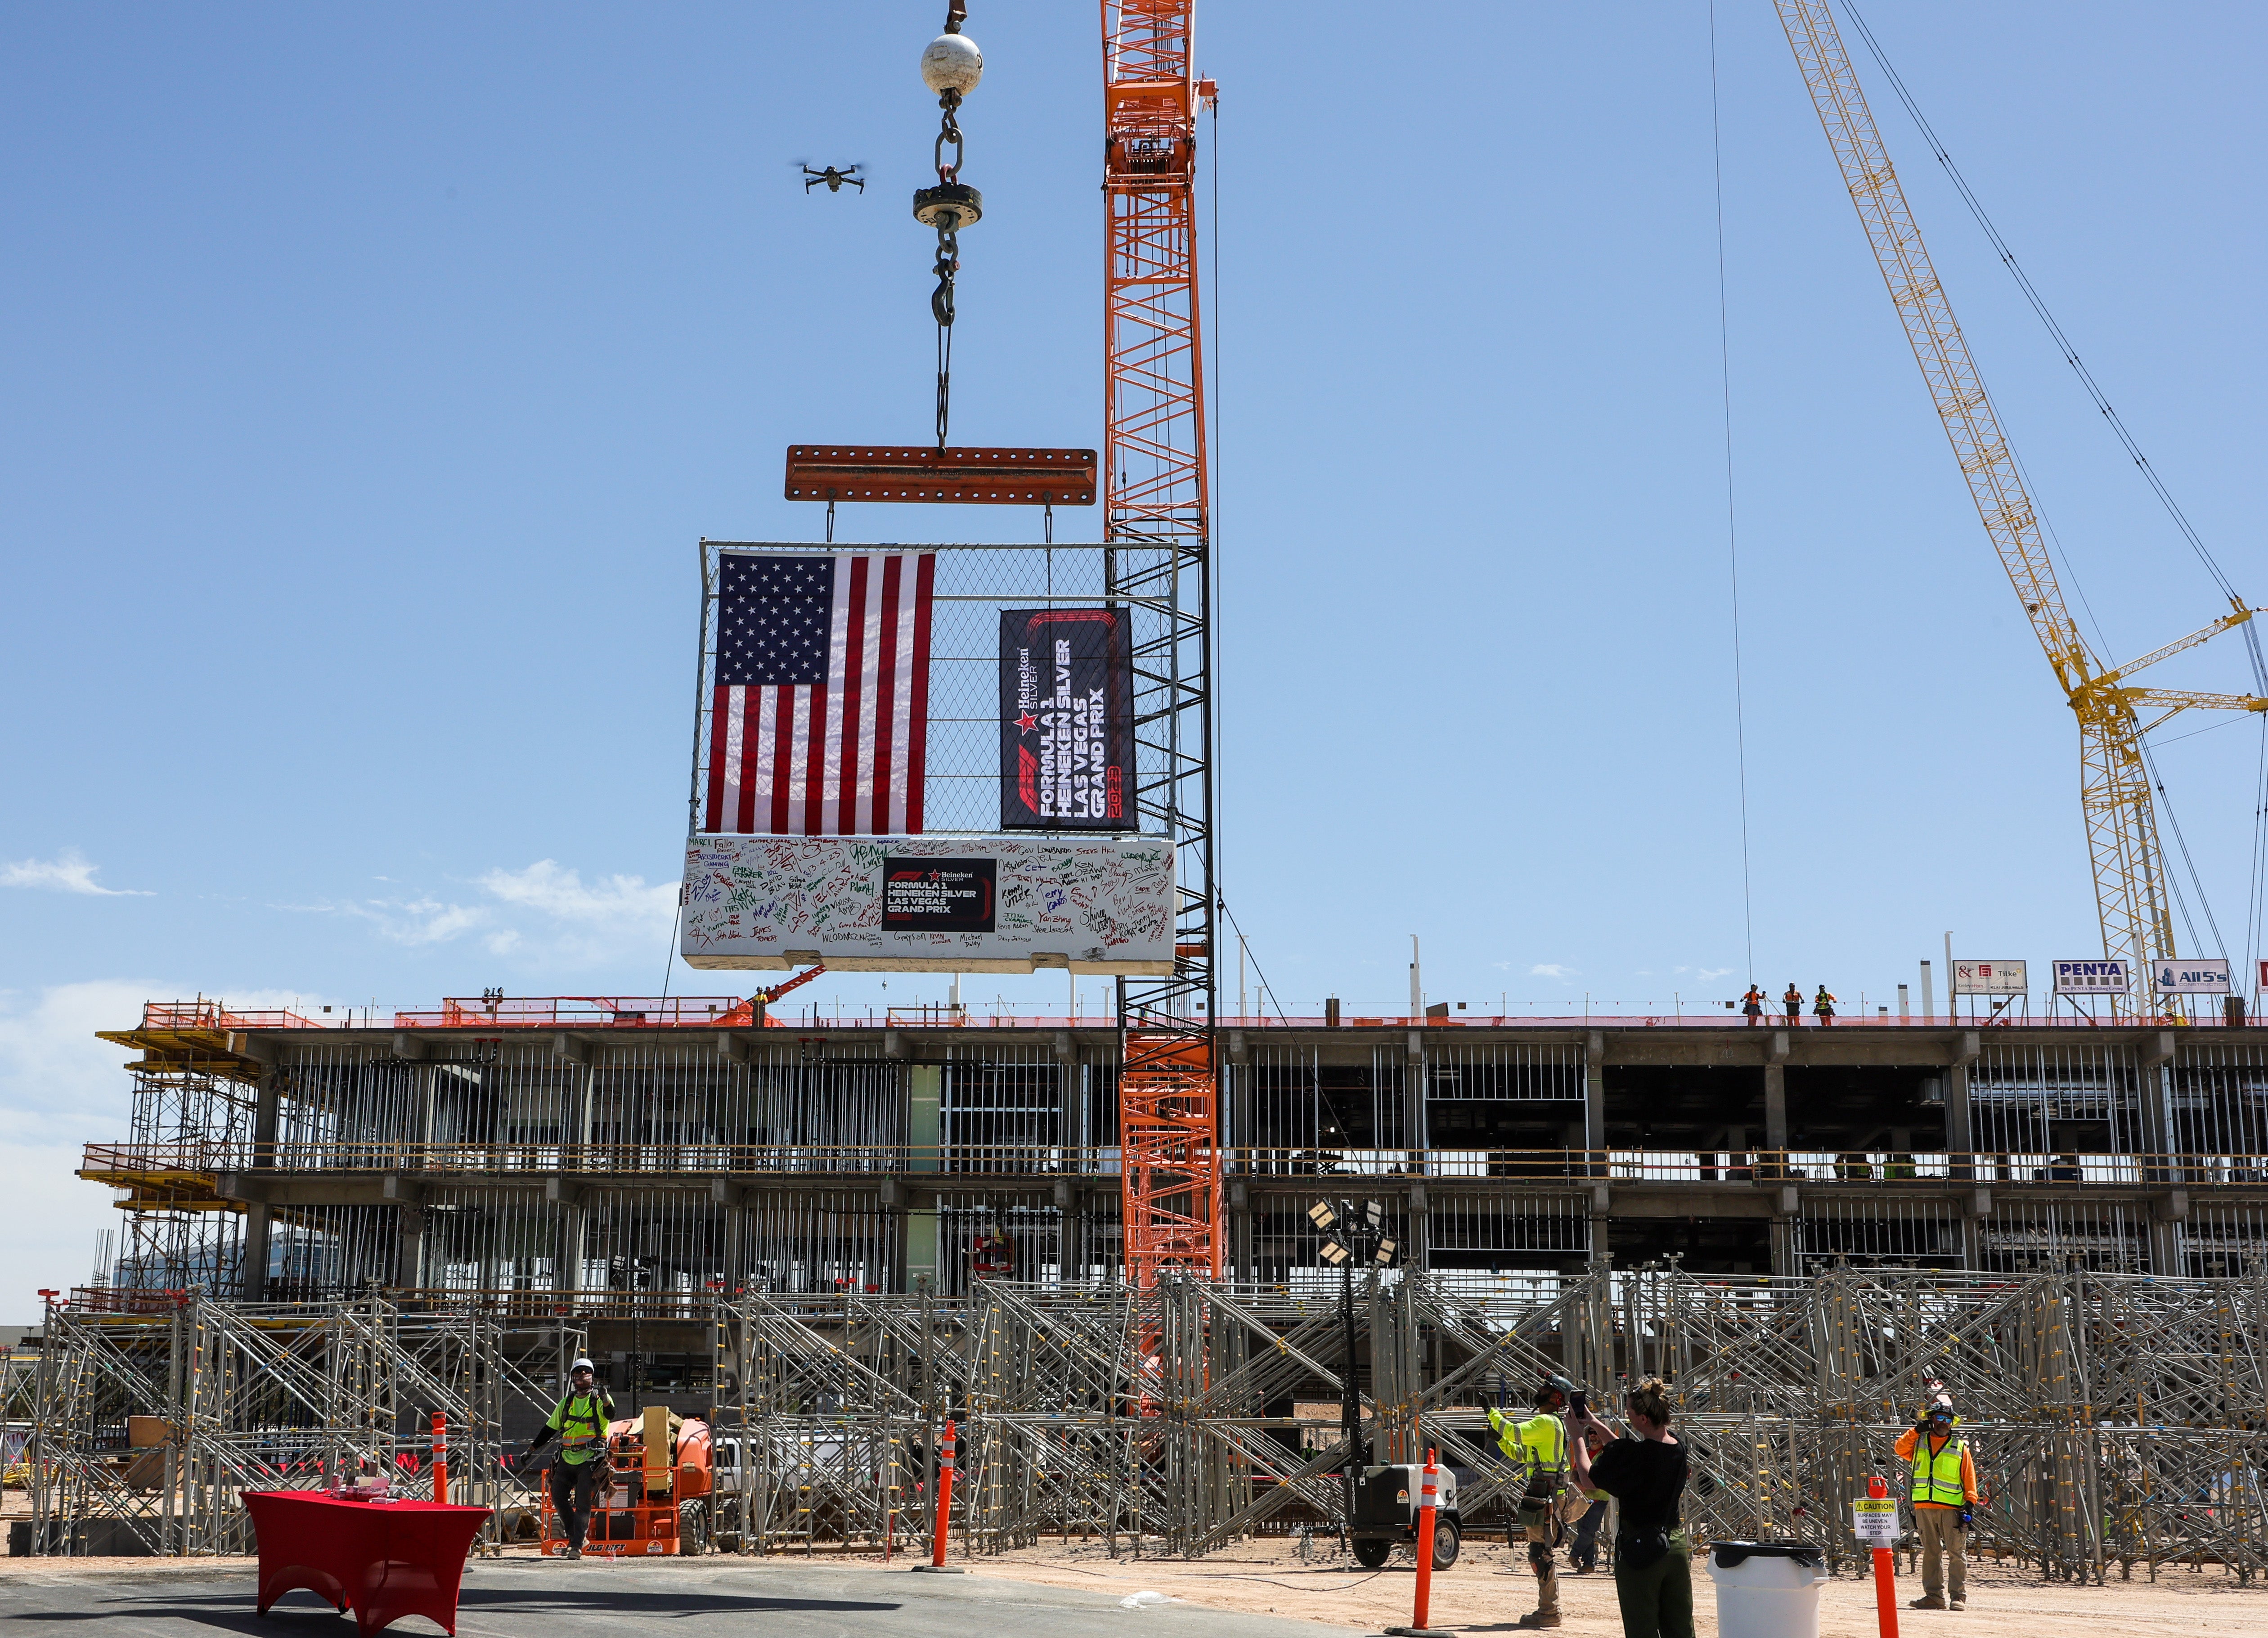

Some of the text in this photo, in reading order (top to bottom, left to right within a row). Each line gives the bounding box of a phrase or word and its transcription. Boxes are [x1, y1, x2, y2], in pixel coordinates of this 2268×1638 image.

[1018, 648, 1029, 709] Heineken
[1029, 666, 1037, 709] SILVER
[1040, 698, 1055, 817] FORMULA 1
[1055, 639, 1072, 817] HEINEKEN SILVER
[1073, 698, 1088, 818] LAS VEGAS
[1089, 688, 1105, 818] GRAND PRIX
[2059, 963, 2122, 976] PENTA
[2179, 972, 2227, 982] All 5's
